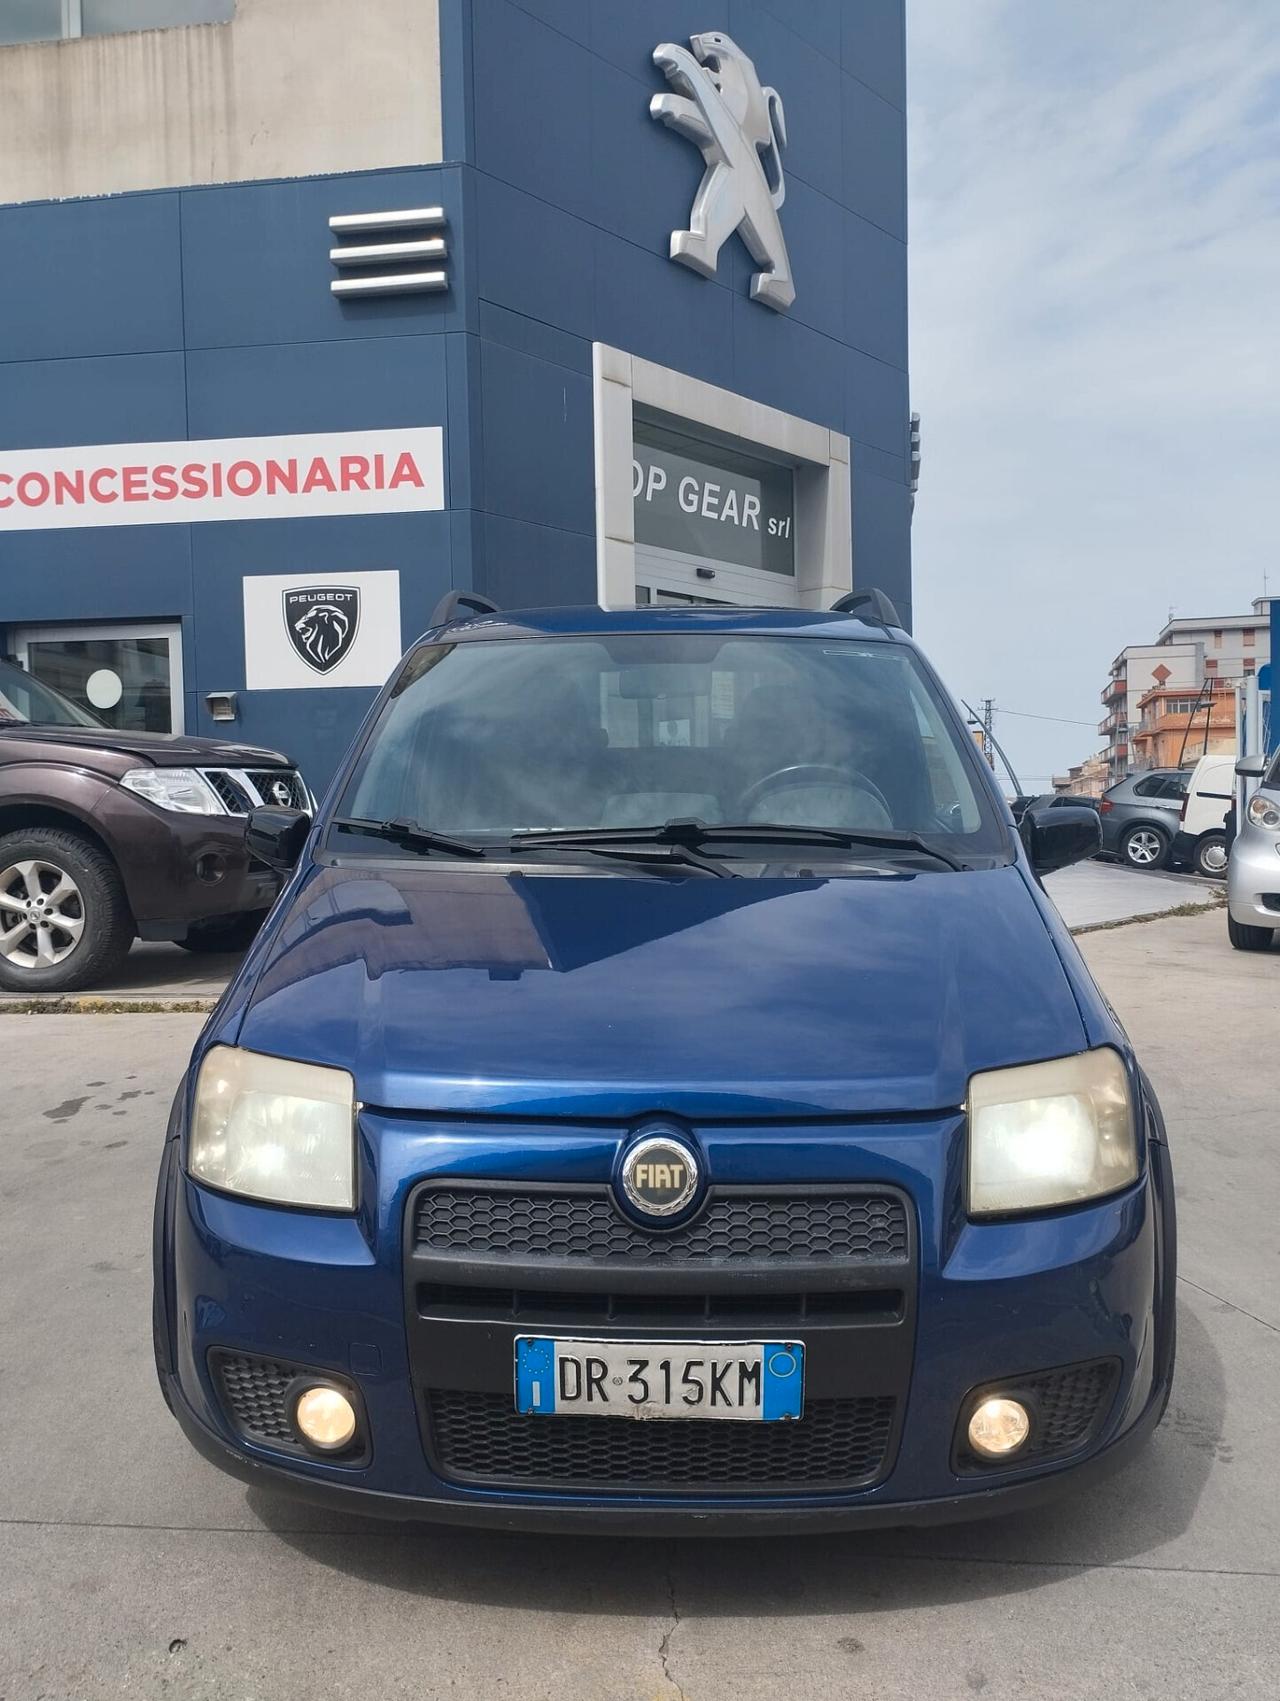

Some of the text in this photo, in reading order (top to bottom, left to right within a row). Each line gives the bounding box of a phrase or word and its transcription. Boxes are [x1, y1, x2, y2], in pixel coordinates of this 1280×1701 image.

[678, 476, 761, 530] GEAR
[767, 516, 791, 539] srl
[289, 593, 353, 604] PEUGEOT
[635, 1164, 684, 1189] FIAT
[558, 1354, 610, 1402] DR
[626, 1358, 762, 1407] 315KM
